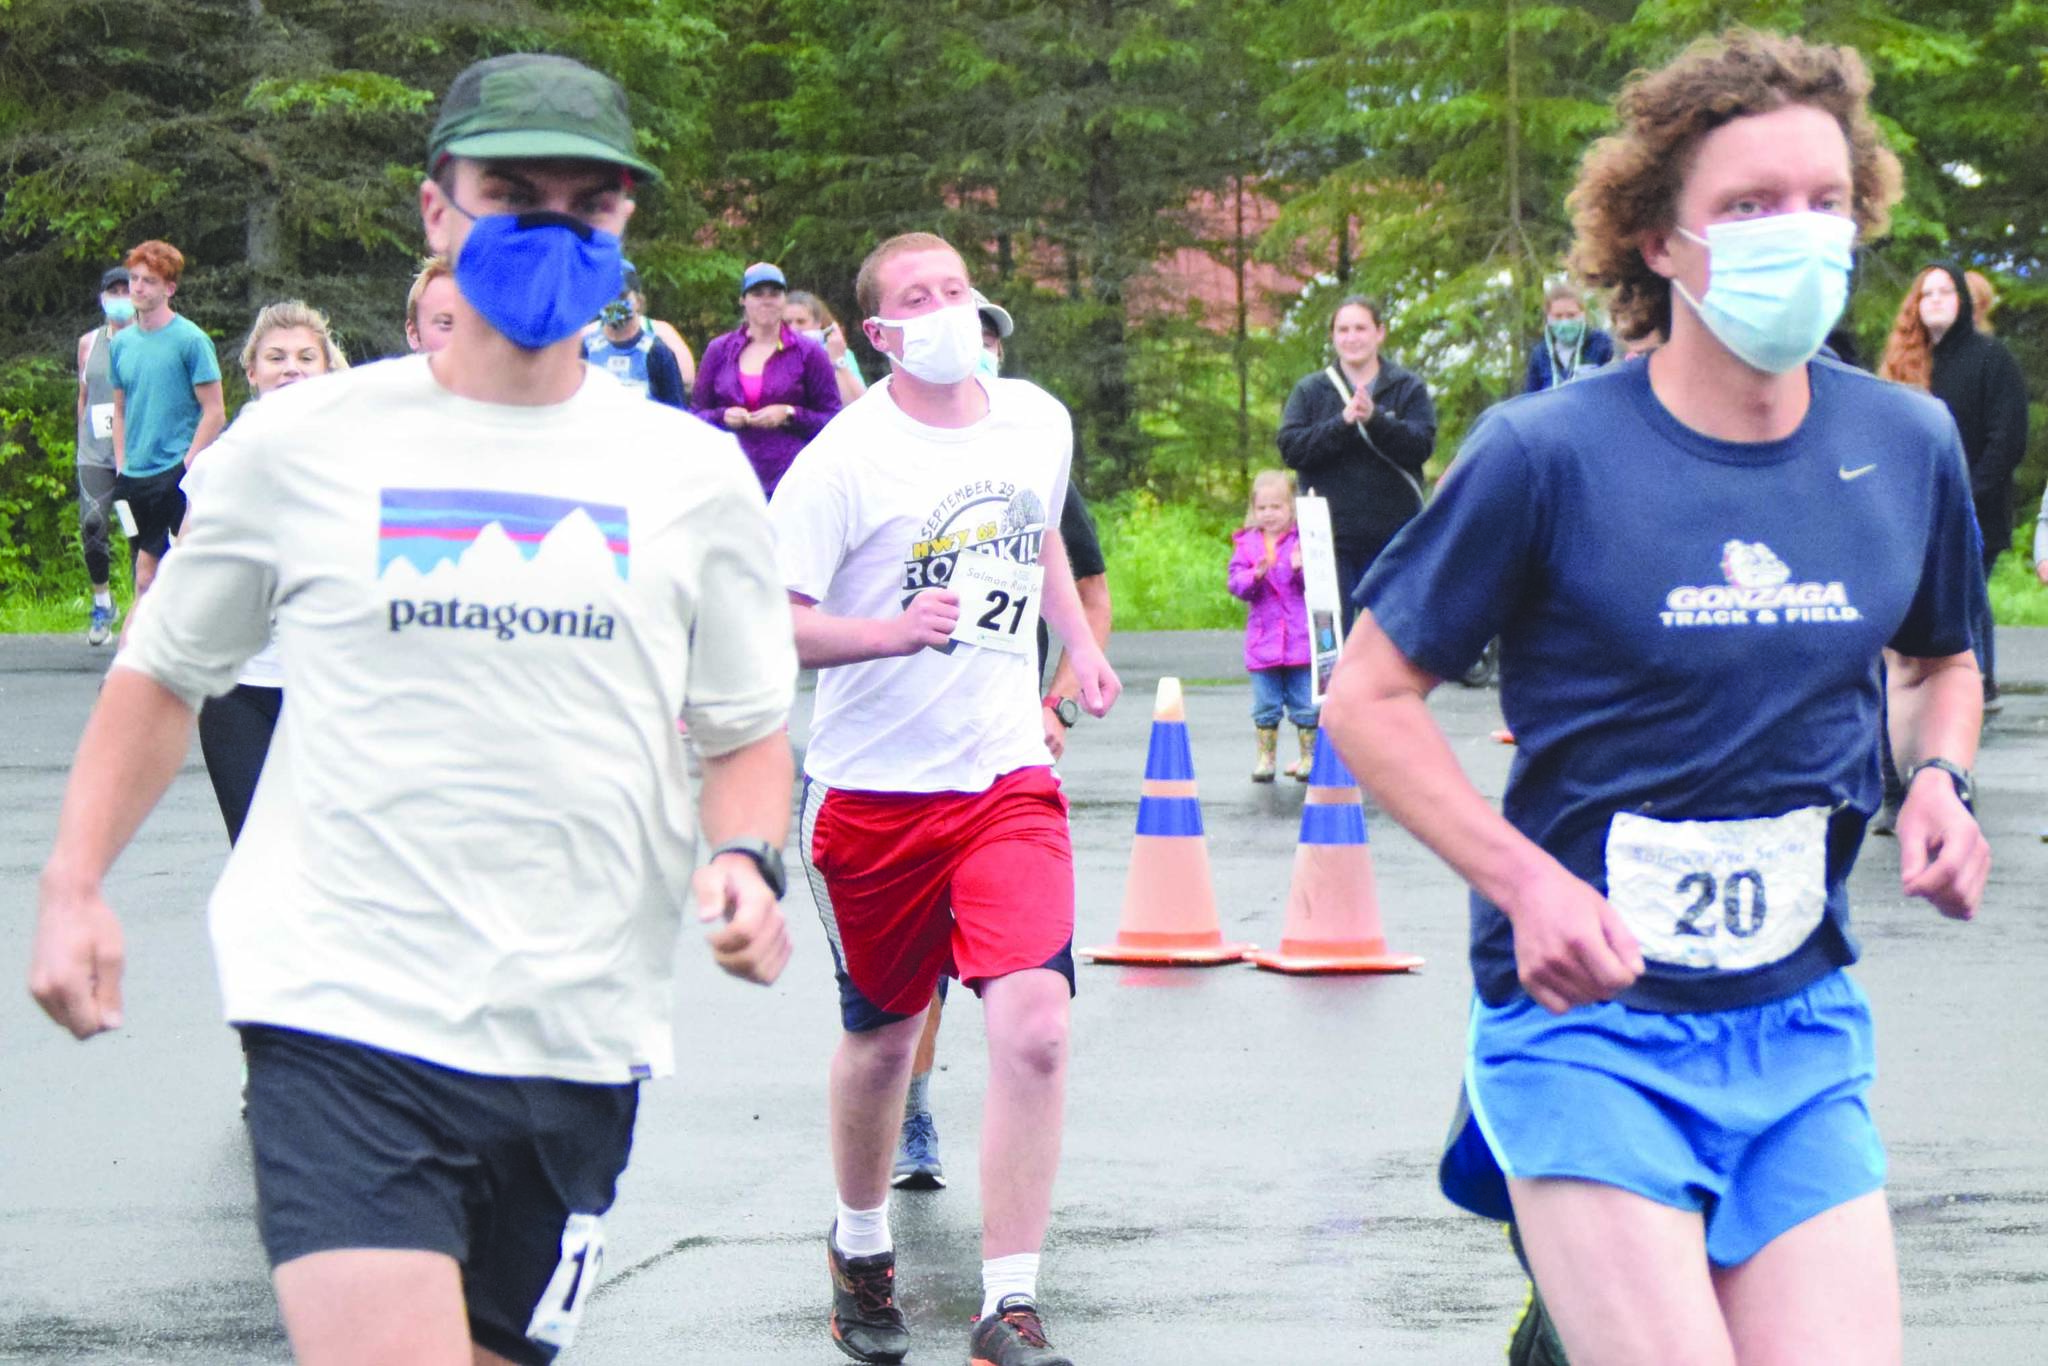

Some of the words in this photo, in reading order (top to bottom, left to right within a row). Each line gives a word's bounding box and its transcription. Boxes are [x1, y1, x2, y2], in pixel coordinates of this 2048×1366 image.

[921, 480, 993, 538] SEPTEMBER
[913, 530, 969, 560] HWY
[967, 567, 1008, 587] Salmon
[976, 589, 1029, 635] 21
[1666, 582, 1847, 610] GONZAGA
[387, 596, 615, 640] patagonia
[1660, 610, 1749, 626] TRACK
[1756, 609, 1778, 624] &
[1785, 607, 1860, 623] FIELD
[1675, 868, 1767, 938] 20
